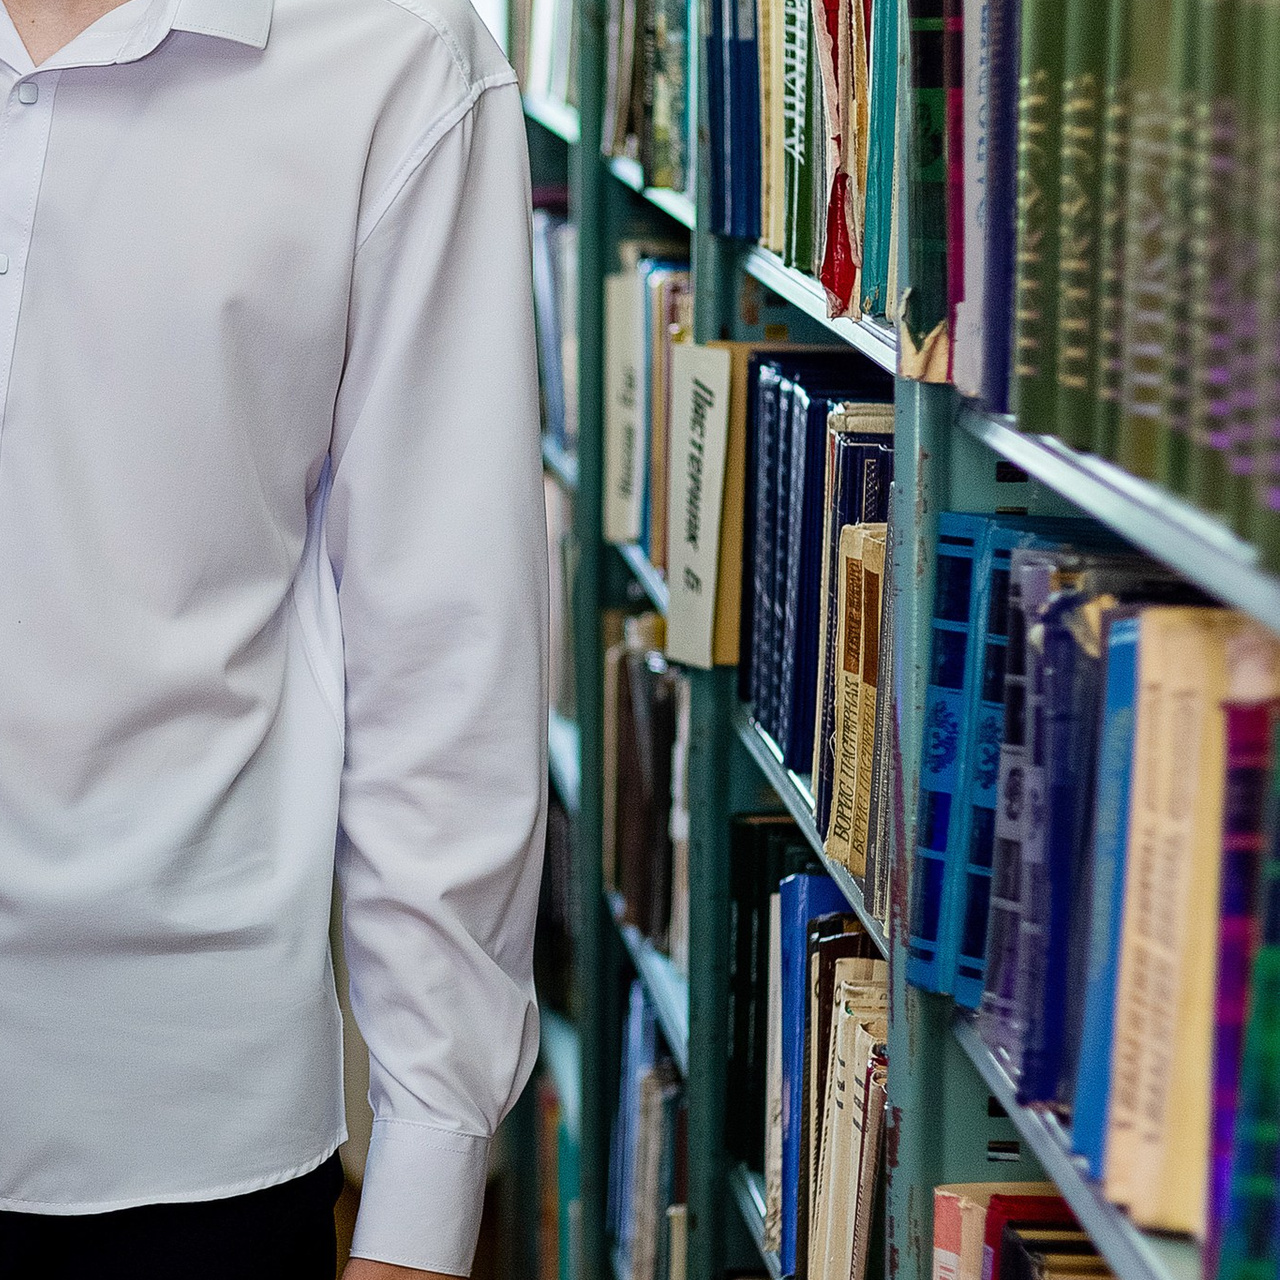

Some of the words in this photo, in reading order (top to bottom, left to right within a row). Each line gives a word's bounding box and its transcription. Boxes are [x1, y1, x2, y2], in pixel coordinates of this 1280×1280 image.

[839, 676, 860, 780] ПАСТЕРНАК
[858, 687, 876, 791] ПАСТЕРНАК
[833, 782, 854, 846] БОРИС
[852, 793, 871, 857] БОРИС
